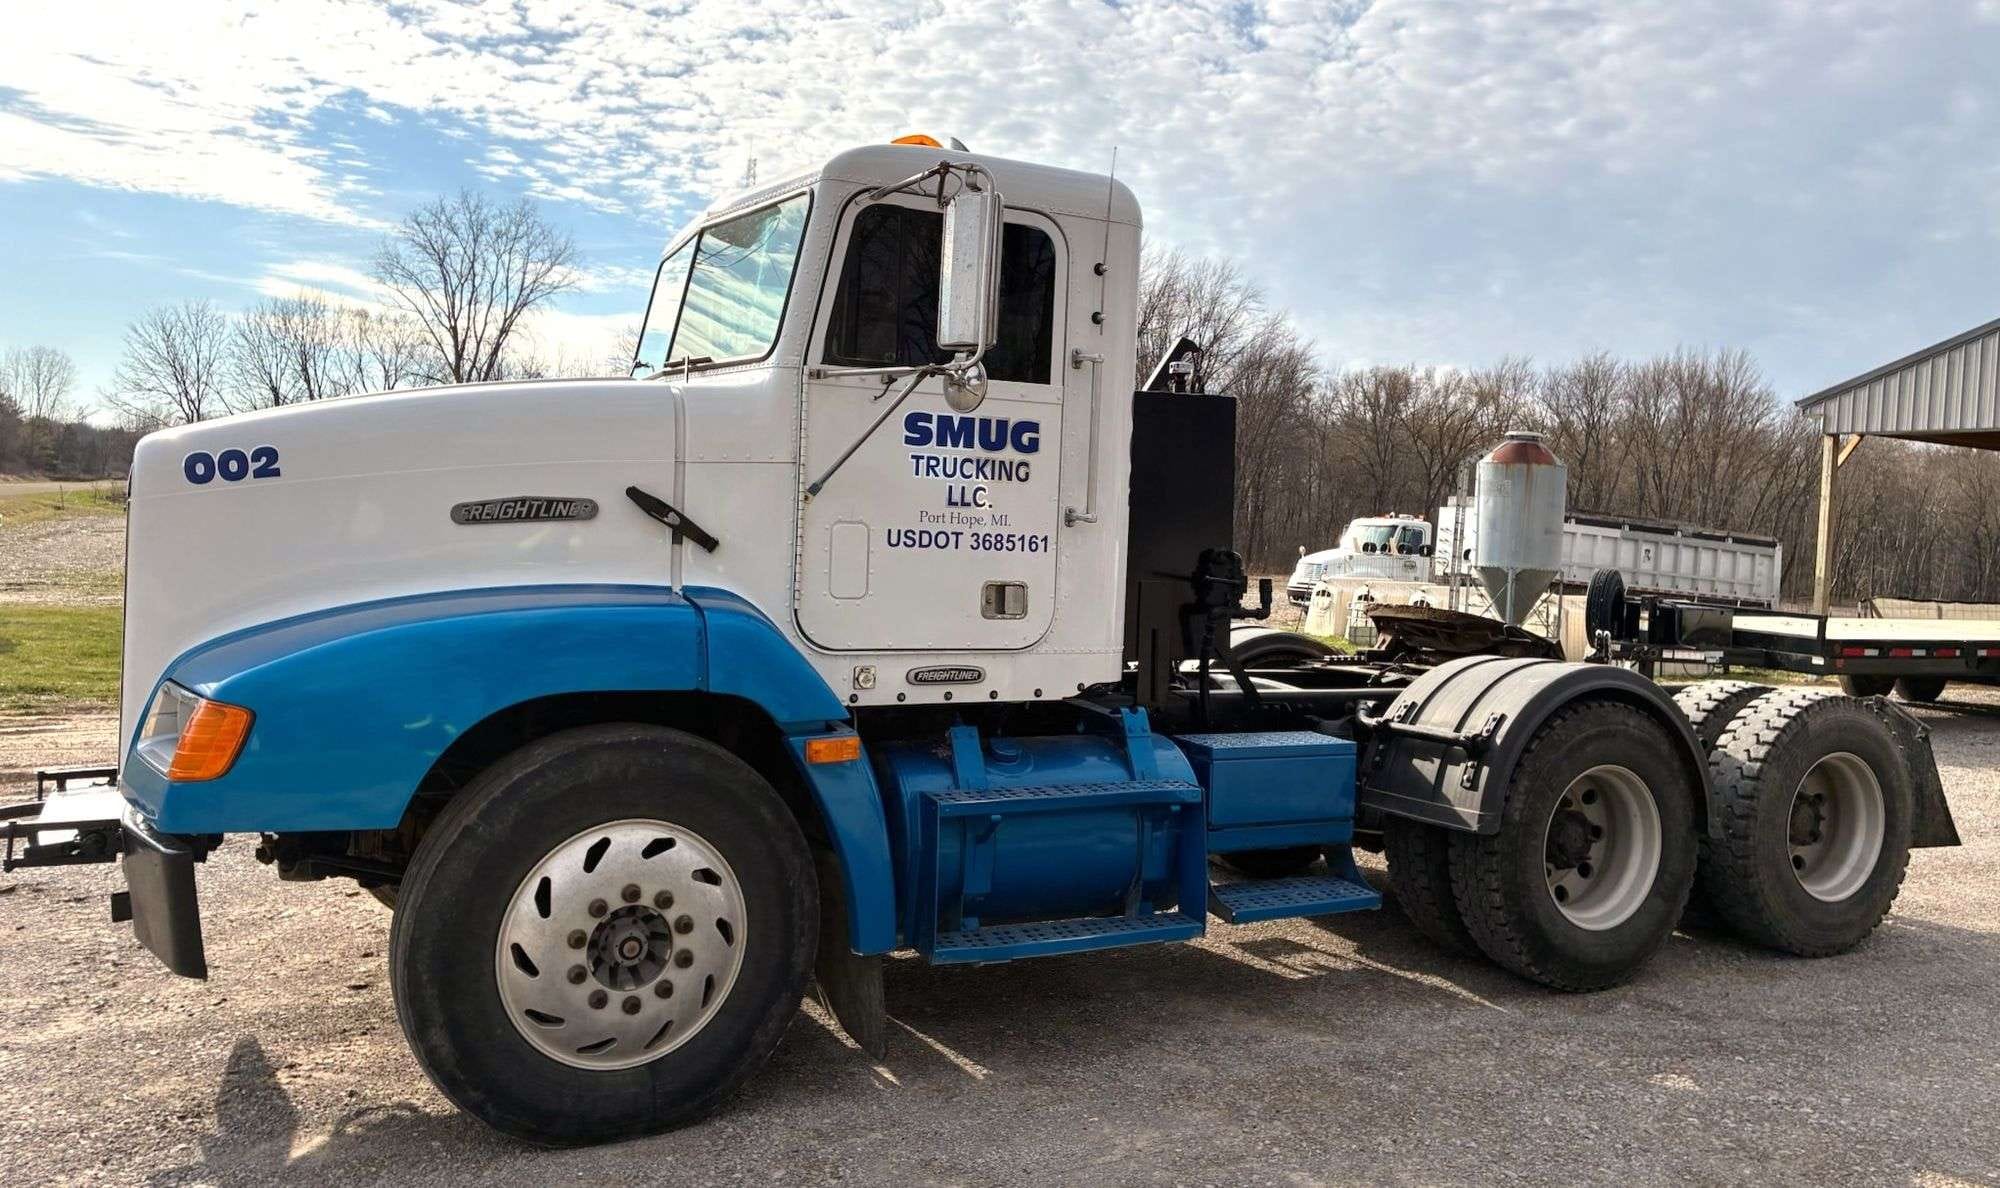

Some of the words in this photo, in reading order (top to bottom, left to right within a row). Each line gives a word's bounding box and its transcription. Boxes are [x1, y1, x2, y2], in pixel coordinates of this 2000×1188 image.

[904, 412, 1040, 453] SMUG
[184, 446, 281, 484] 002
[911, 454, 1030, 482] TRUCKING
[947, 485, 993, 508] LLC.
[461, 500, 593, 521] FREIGHTLINER
[919, 510, 946, 524] Port
[950, 512, 987, 528] Hope,
[991, 514, 1012, 527] MI.
[887, 529, 964, 550] USDOT
[970, 533, 1048, 552] 3685161
[917, 670, 979, 681] FREIGHTLINER
